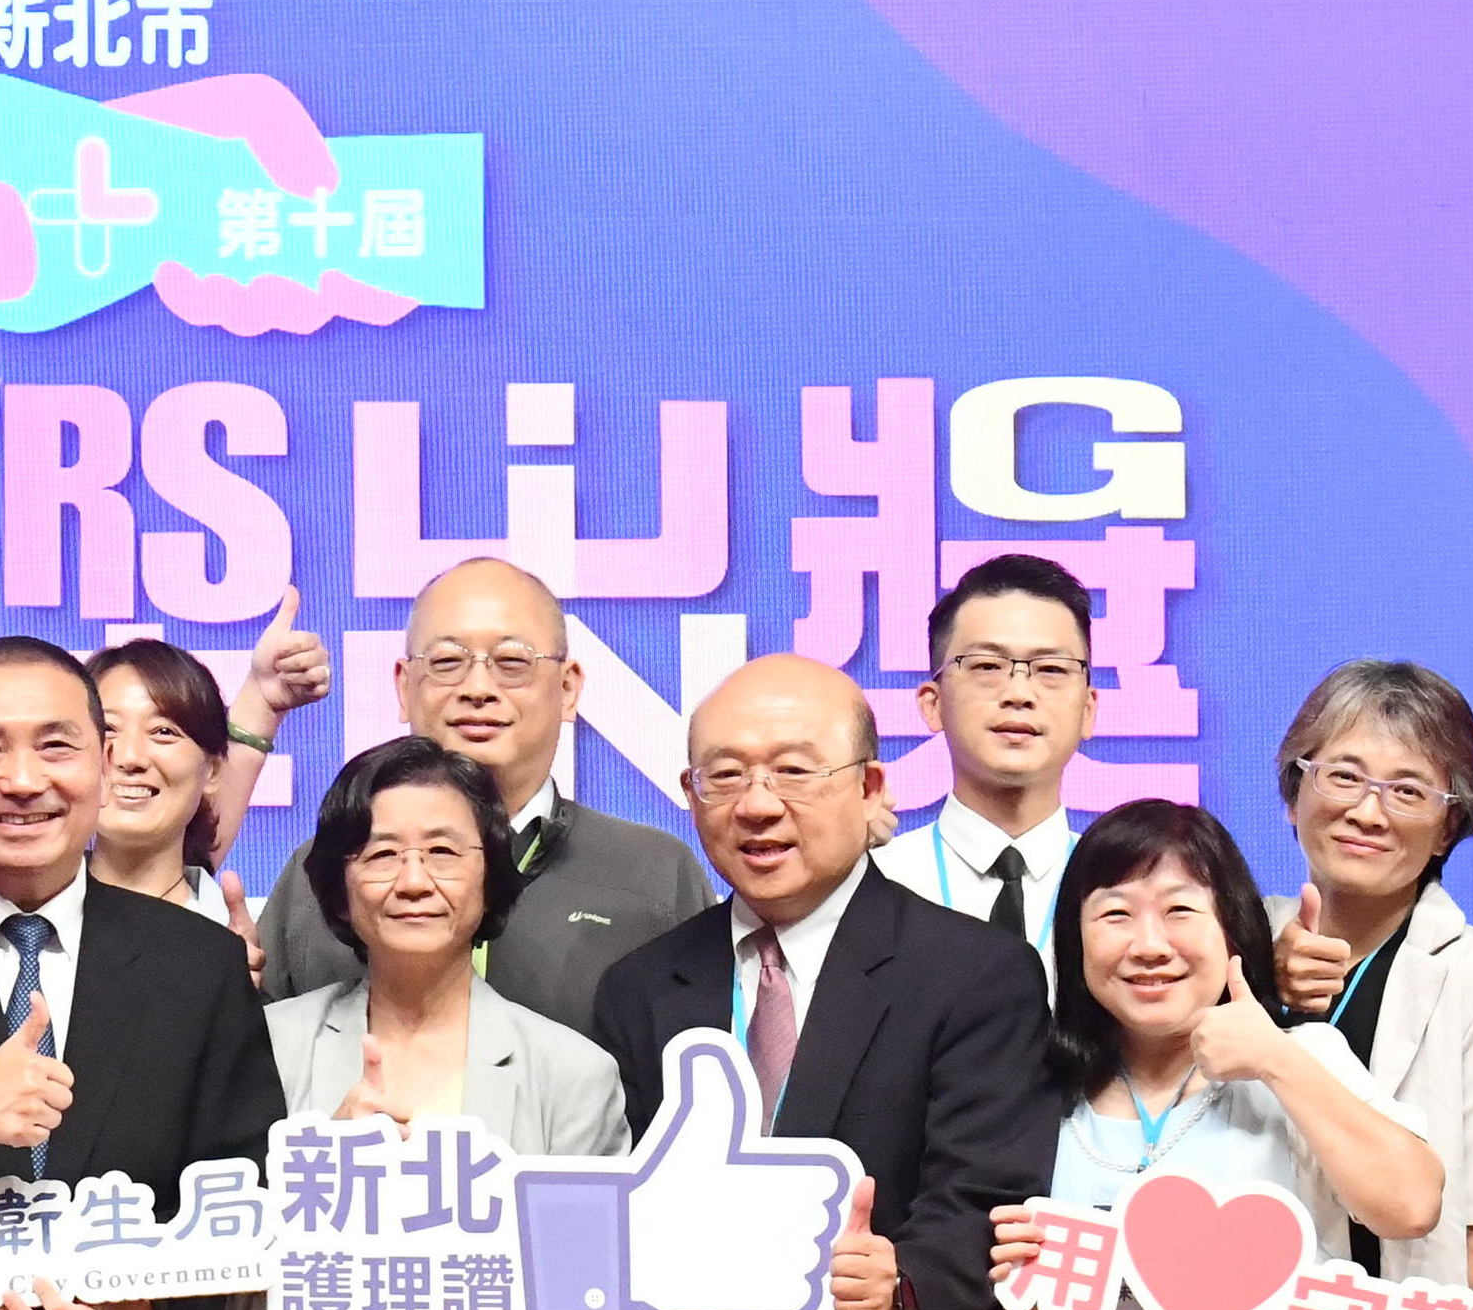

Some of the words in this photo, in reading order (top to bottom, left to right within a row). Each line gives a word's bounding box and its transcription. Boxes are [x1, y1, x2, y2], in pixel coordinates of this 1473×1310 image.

[216, 186, 427, 259] 第十屆
[280, 1126, 503, 1236] 新北
[84, 1262, 265, 1291] Government
